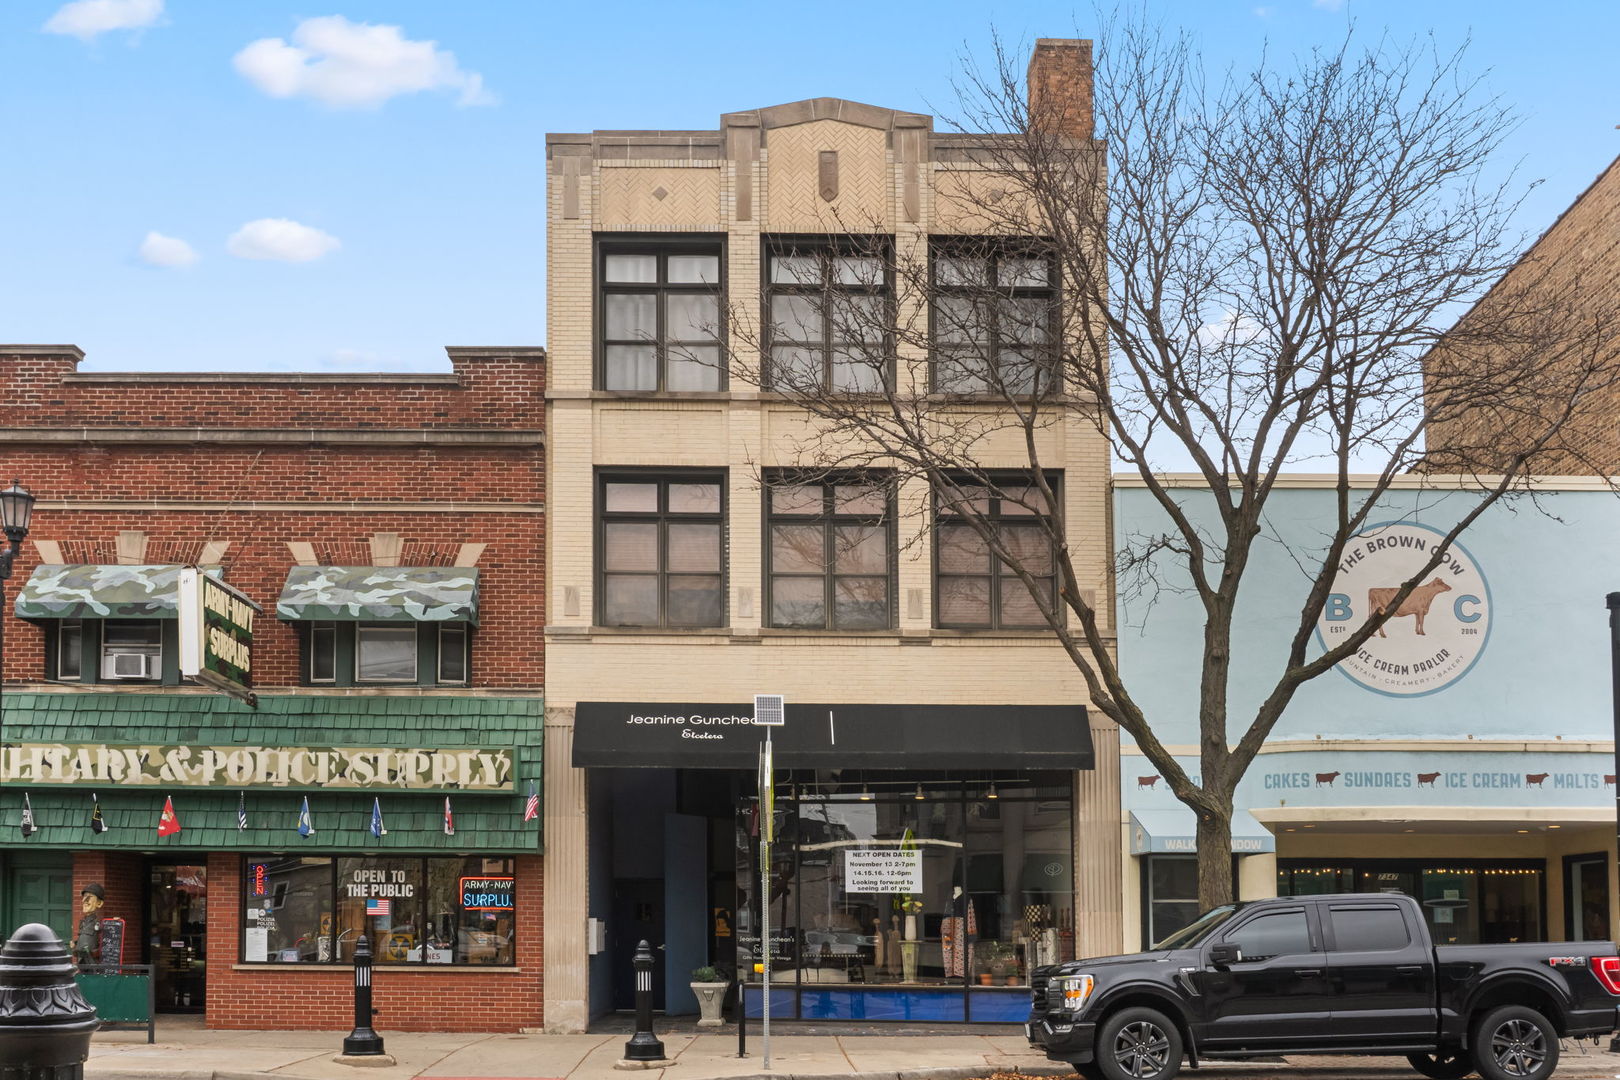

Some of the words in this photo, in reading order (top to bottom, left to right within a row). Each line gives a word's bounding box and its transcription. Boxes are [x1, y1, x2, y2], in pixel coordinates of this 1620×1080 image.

[1337, 548, 1366, 576] THE
[1366, 535, 1426, 553] BROWN
[204, 582, 254, 634] ARMY-NAVY
[1325, 593, 1354, 622] B
[1453, 594, 1482, 624] C
[210, 626, 251, 673] SURPLUS
[1373, 659, 1409, 675] CREAM
[1413, 648, 1451, 675] PARLOR
[1344, 656, 1377, 680] OUNTAIN
[1384, 678, 1431, 687] CREAMERY
[1437, 655, 1465, 678] BAKERY
[626, 714, 686, 725] Jeanine
[681, 728, 724, 740] Etcetera
[160, 746, 200, 782] &
[201, 749, 341, 784] POLICE
[351, 751, 507, 786] SUPPLY
[1264, 772, 1310, 789] CAKES
[1344, 772, 1412, 789] SUNDAES
[1445, 772, 1468, 788] ICE
[1472, 772, 1521, 789] CREAM
[1554, 773, 1600, 789] MALTS
[256, 865, 265, 895] OPEN
[353, 870, 386, 883] OPEN
[391, 870, 406, 883] TO
[464, 880, 514, 889] ARMY-NAV
[346, 884, 368, 897] THE
[371, 884, 414, 897] PUBLIC
[1549, 956, 1586, 966] FX4
